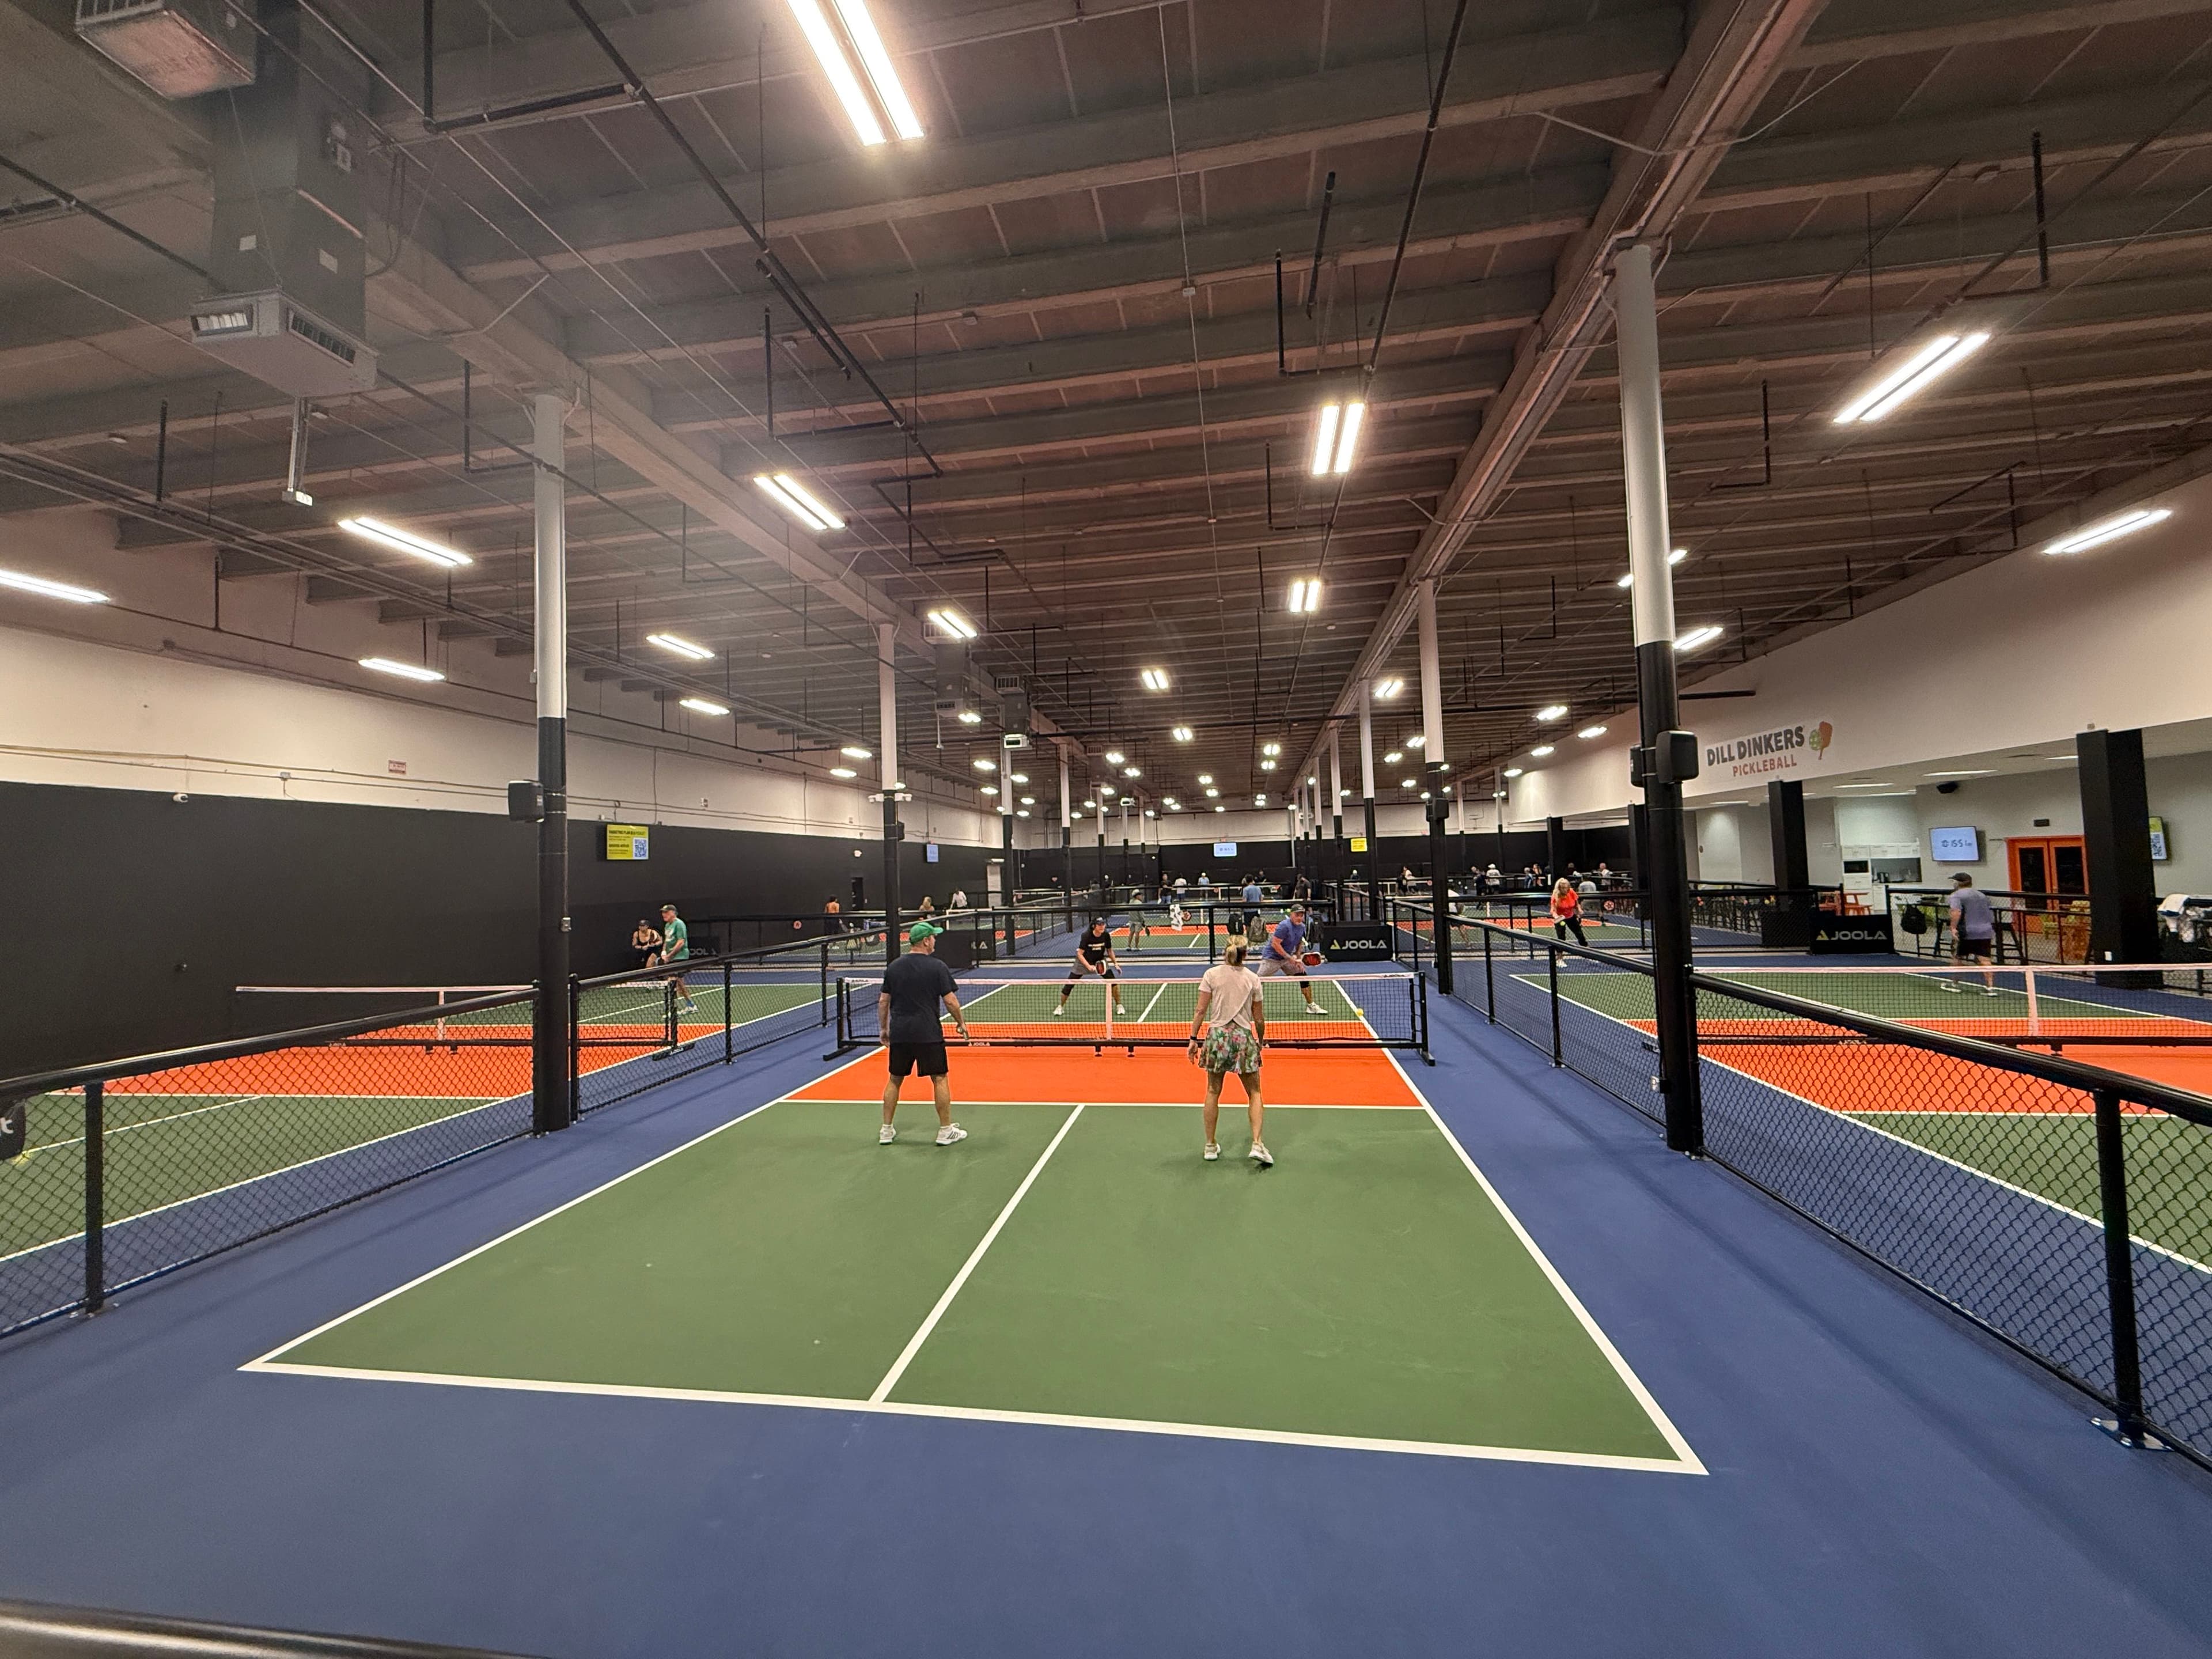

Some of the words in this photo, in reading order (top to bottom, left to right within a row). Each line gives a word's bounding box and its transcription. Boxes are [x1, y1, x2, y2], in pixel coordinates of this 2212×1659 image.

[1706, 744, 1735, 767] DILL
[1737, 725, 1805, 760] DINKERS
[1732, 753, 1797, 777] PICKLEBALL
[1830, 930, 1888, 941] JOOLA
[1342, 940, 1388, 950] JOOLA
[690, 948, 717, 956] OOLA
